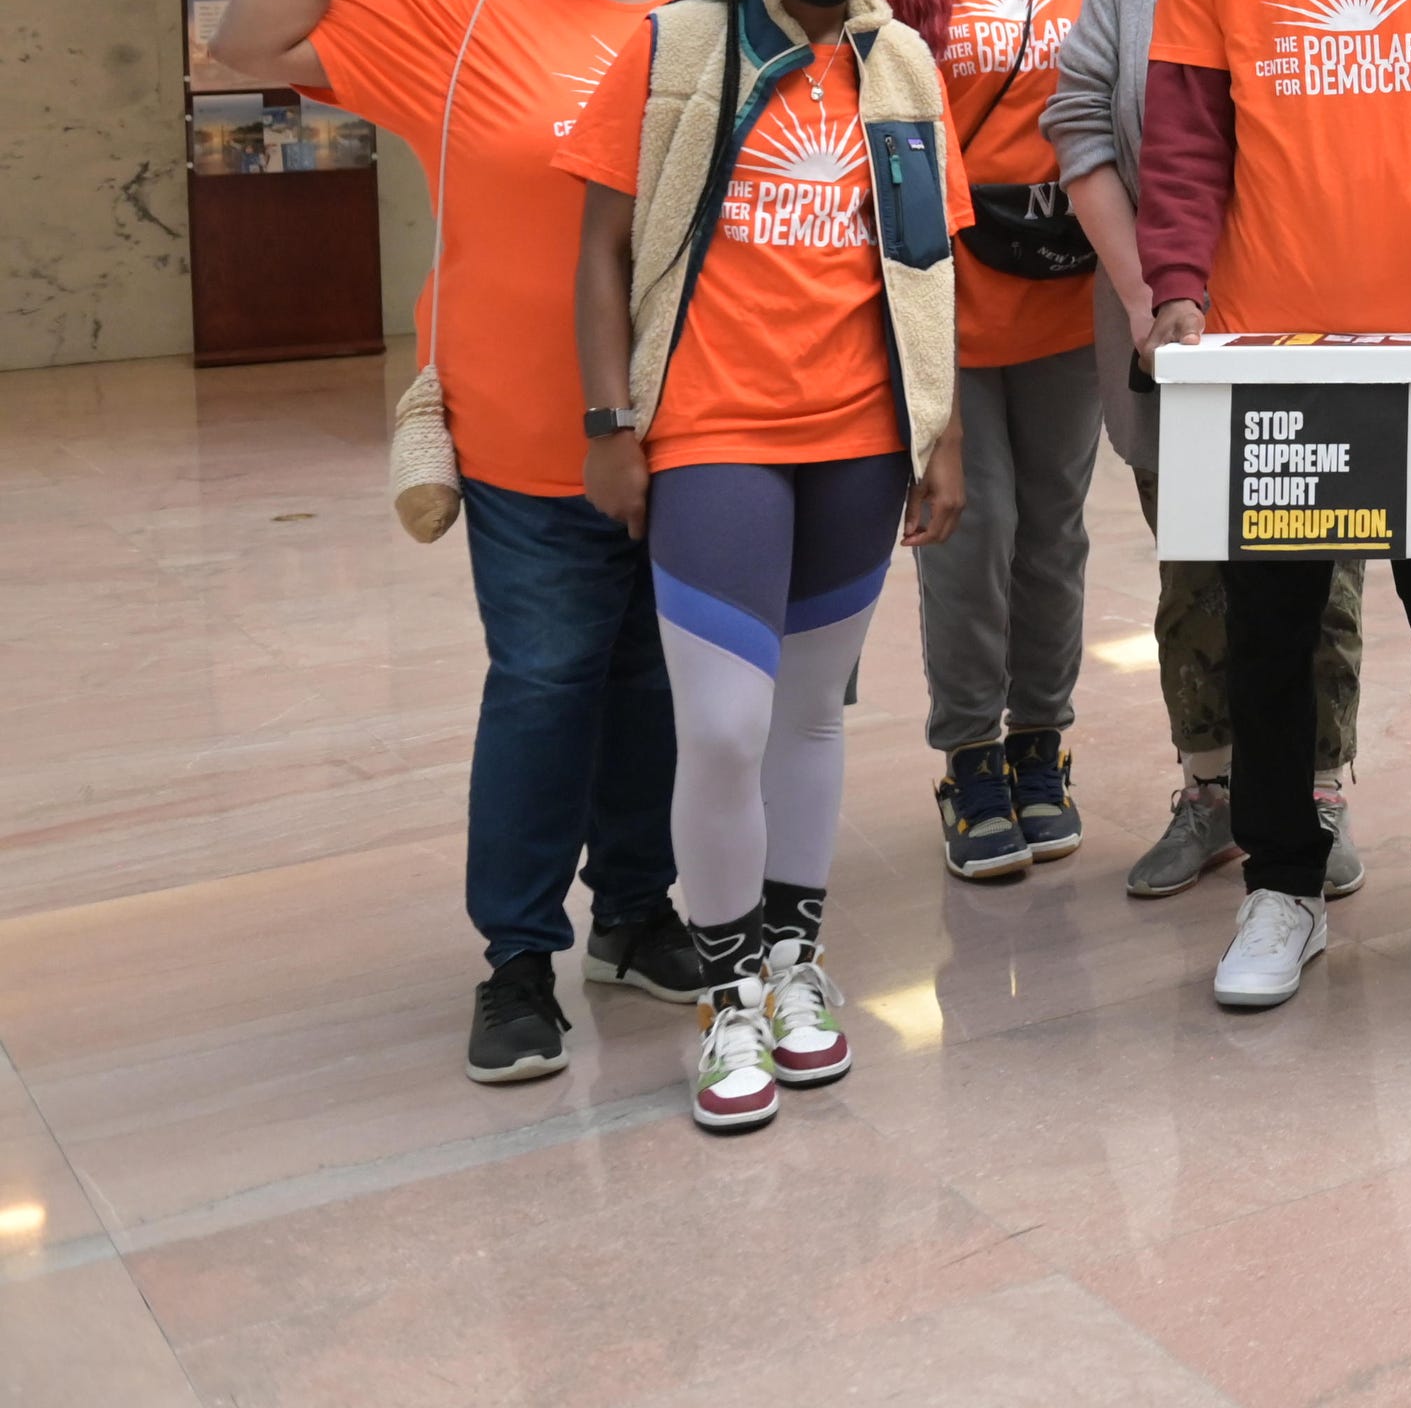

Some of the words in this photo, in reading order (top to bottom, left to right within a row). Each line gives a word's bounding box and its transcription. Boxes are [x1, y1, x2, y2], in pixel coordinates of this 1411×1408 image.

[948, 24, 970, 39] THE
[940, 42, 973, 62] NTER
[1274, 36, 1298, 53] THE
[977, 42, 1060, 73] DEMOCR
[1255, 57, 1300, 77] CENTER
[952, 62, 976, 78] FOR
[1275, 79, 1302, 96] FOR
[727, 180, 753, 198] THE
[724, 225, 749, 243] FOR
[753, 211, 877, 248] DEMOCRA
[1244, 411, 1304, 440] STOP
[1243, 443, 1350, 473] SUPREME
[1242, 476, 1319, 506] COURT
[1242, 509, 1393, 539] CORRUPTION.
